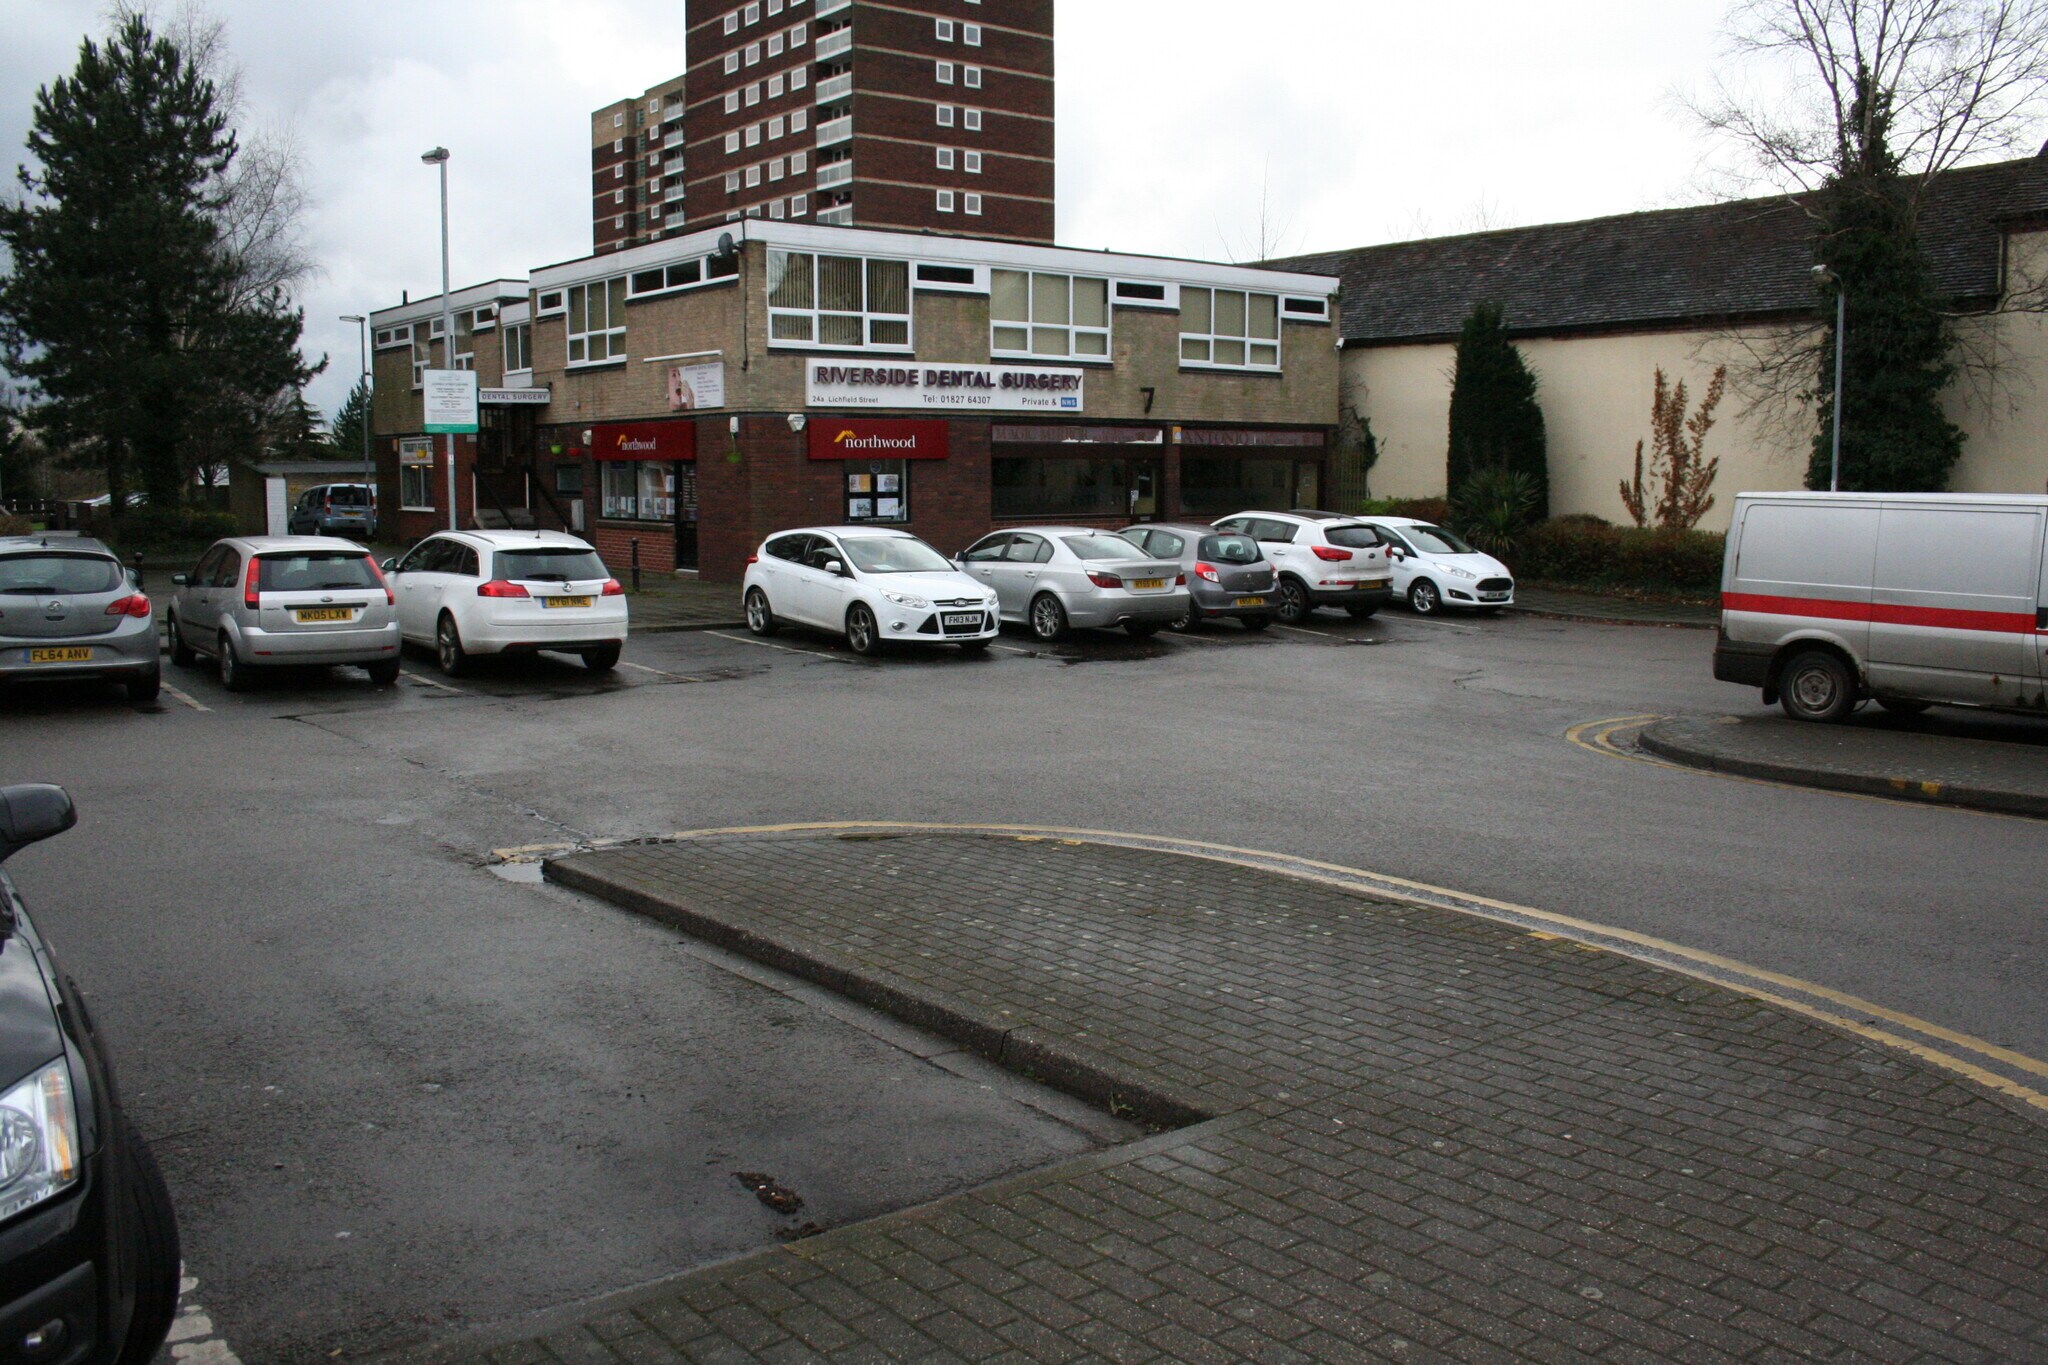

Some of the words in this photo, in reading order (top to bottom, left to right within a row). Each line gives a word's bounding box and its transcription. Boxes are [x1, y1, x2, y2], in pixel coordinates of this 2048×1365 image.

[815, 366, 919, 386] RIVERSIDE
[925, 369, 996, 388] DENTAL
[1001, 372, 1082, 390] SURGERY
[828, 395, 857, 403] Lichfield
[923, 394, 938, 403] Tel:
[940, 395, 965, 403] 01827
[967, 396, 991, 404] 64307
[1022, 397, 1049, 406] Private
[1051, 398, 1057, 406] &
[1061, 398, 1077, 406] NHS
[621, 437, 656, 450] northwood
[845, 435, 916, 448] northwood
[32, 651, 64, 661] FL64
[67, 649, 90, 660] ANV
